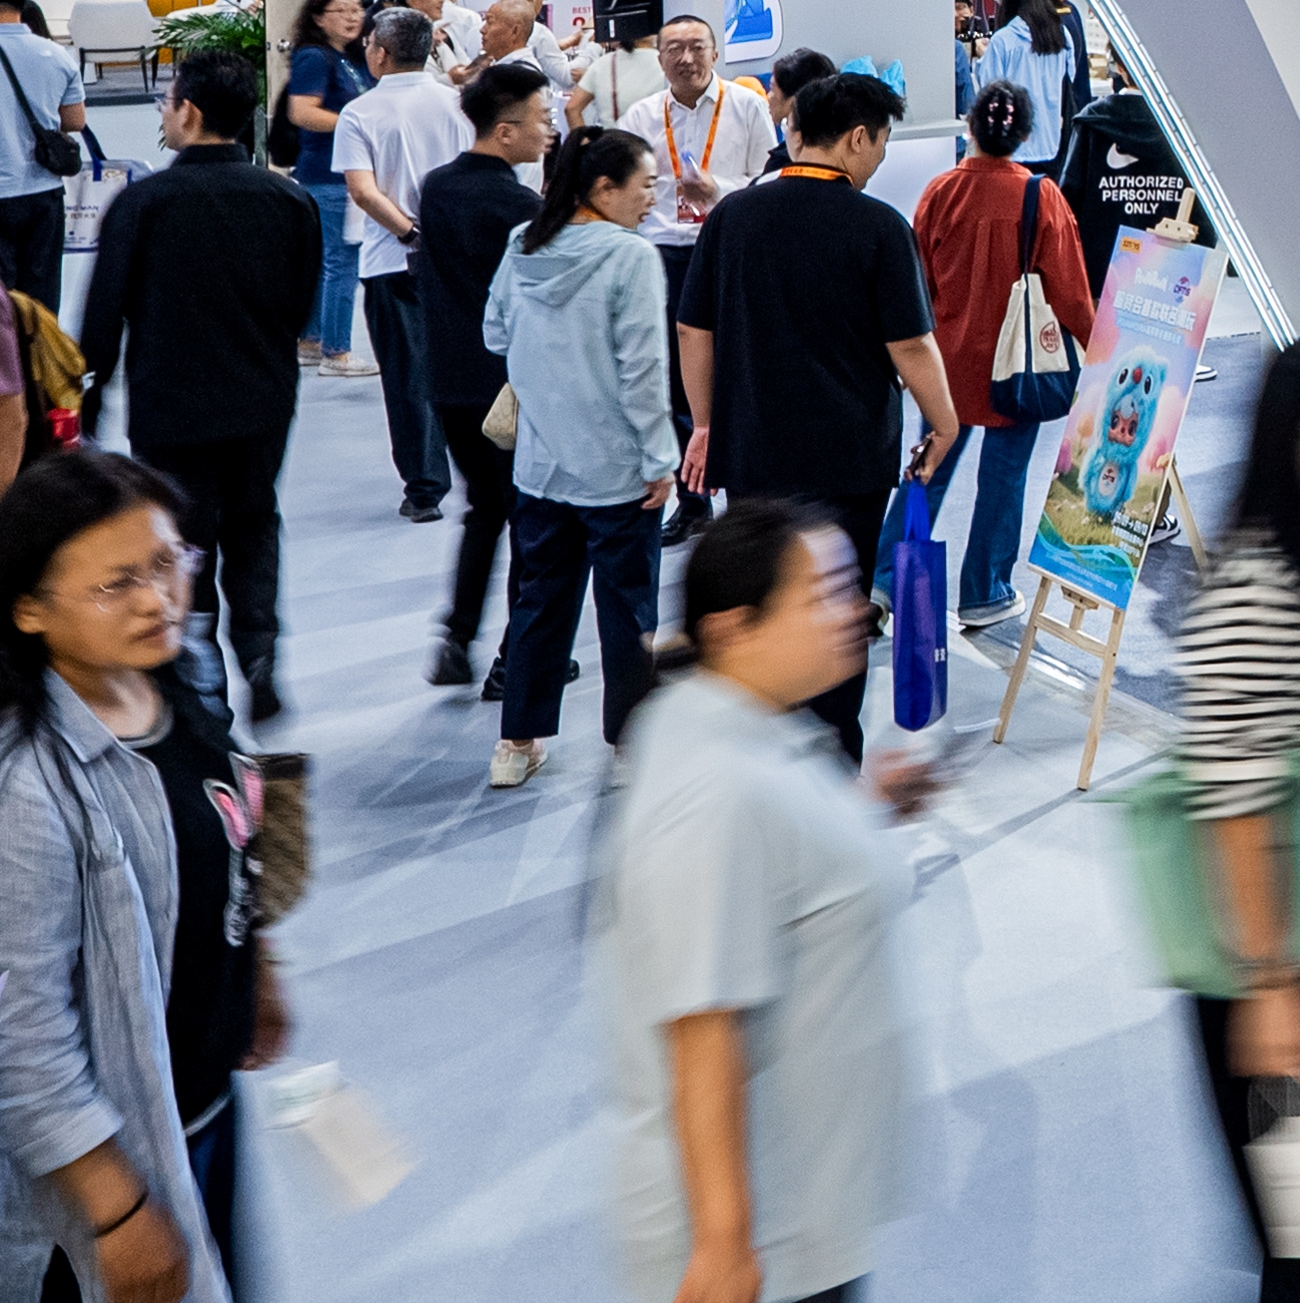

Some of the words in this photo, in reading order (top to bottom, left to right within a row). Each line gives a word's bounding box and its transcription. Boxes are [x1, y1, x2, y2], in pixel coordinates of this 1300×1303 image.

[1099, 176, 1184, 189] AUTHORIZED
[1102, 189, 1182, 202] PERSONNEL
[1124, 202, 1159, 215] ONLY
